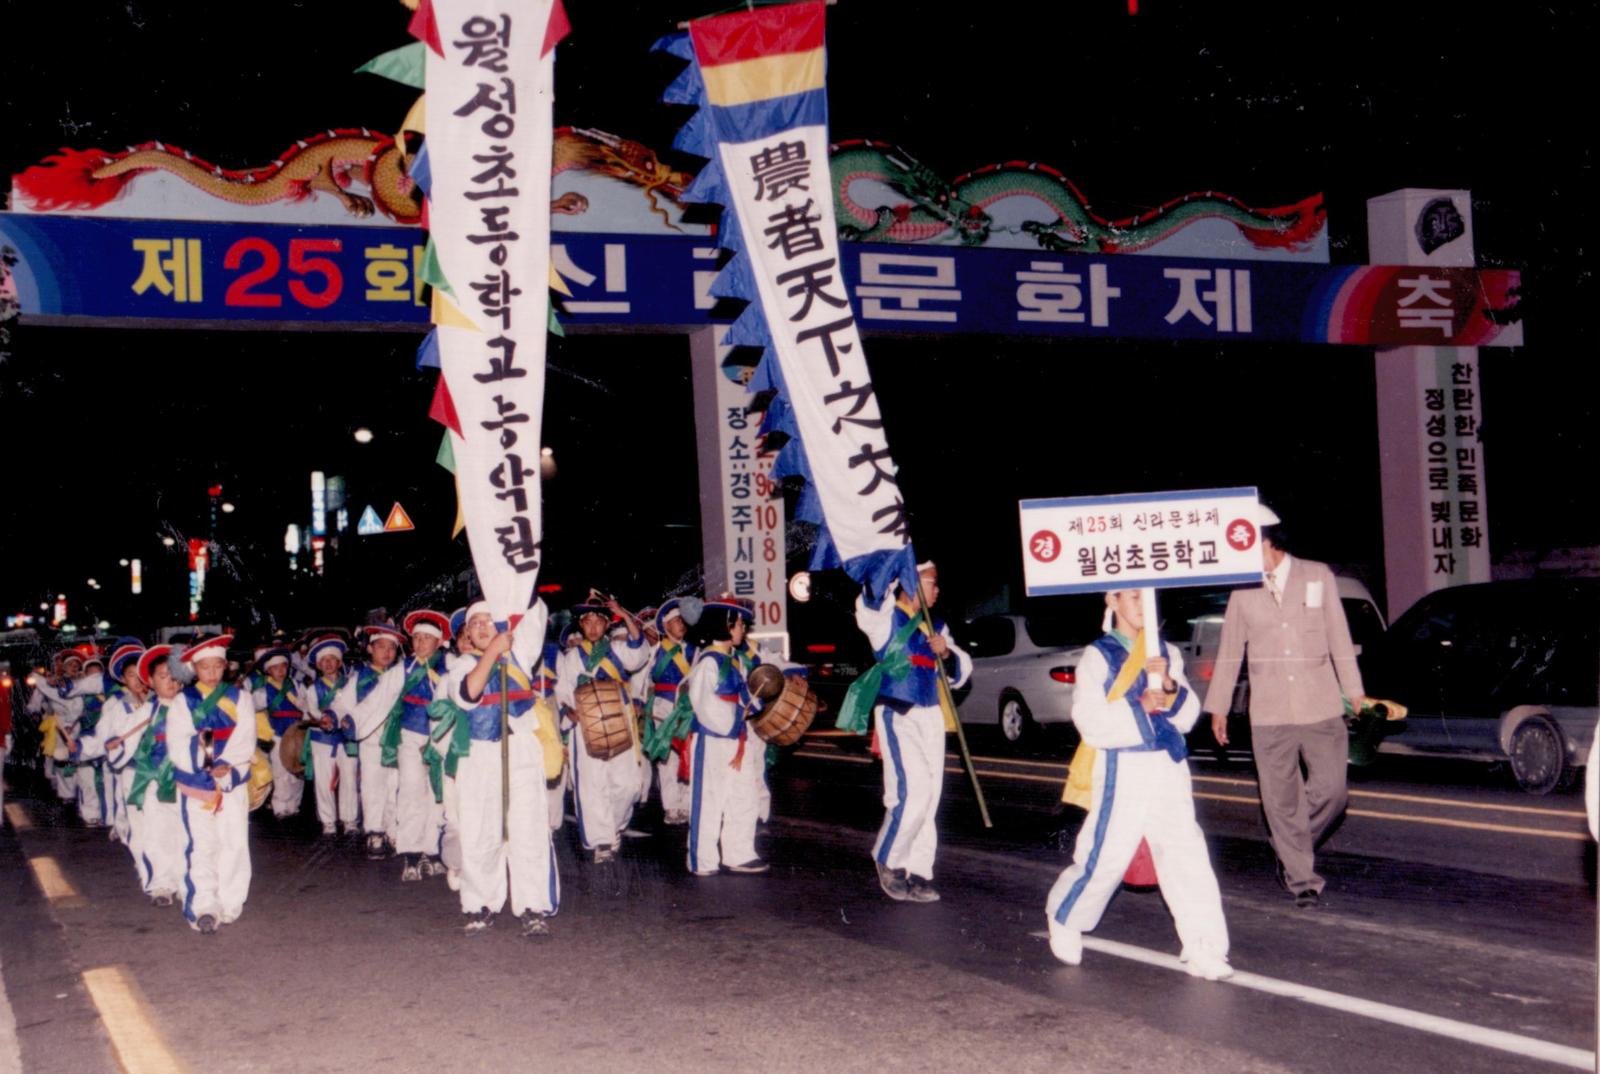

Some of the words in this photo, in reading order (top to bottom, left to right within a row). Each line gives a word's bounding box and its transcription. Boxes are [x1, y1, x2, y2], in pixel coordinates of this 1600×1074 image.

[1396, 274, 1455, 338] 축
[1067, 516, 1123, 536] 제25회
[1132, 508, 1220, 532] 신라문화제
[1034, 535, 1056, 559] 경
[1076, 540, 1220, 577] 월성초등학교
